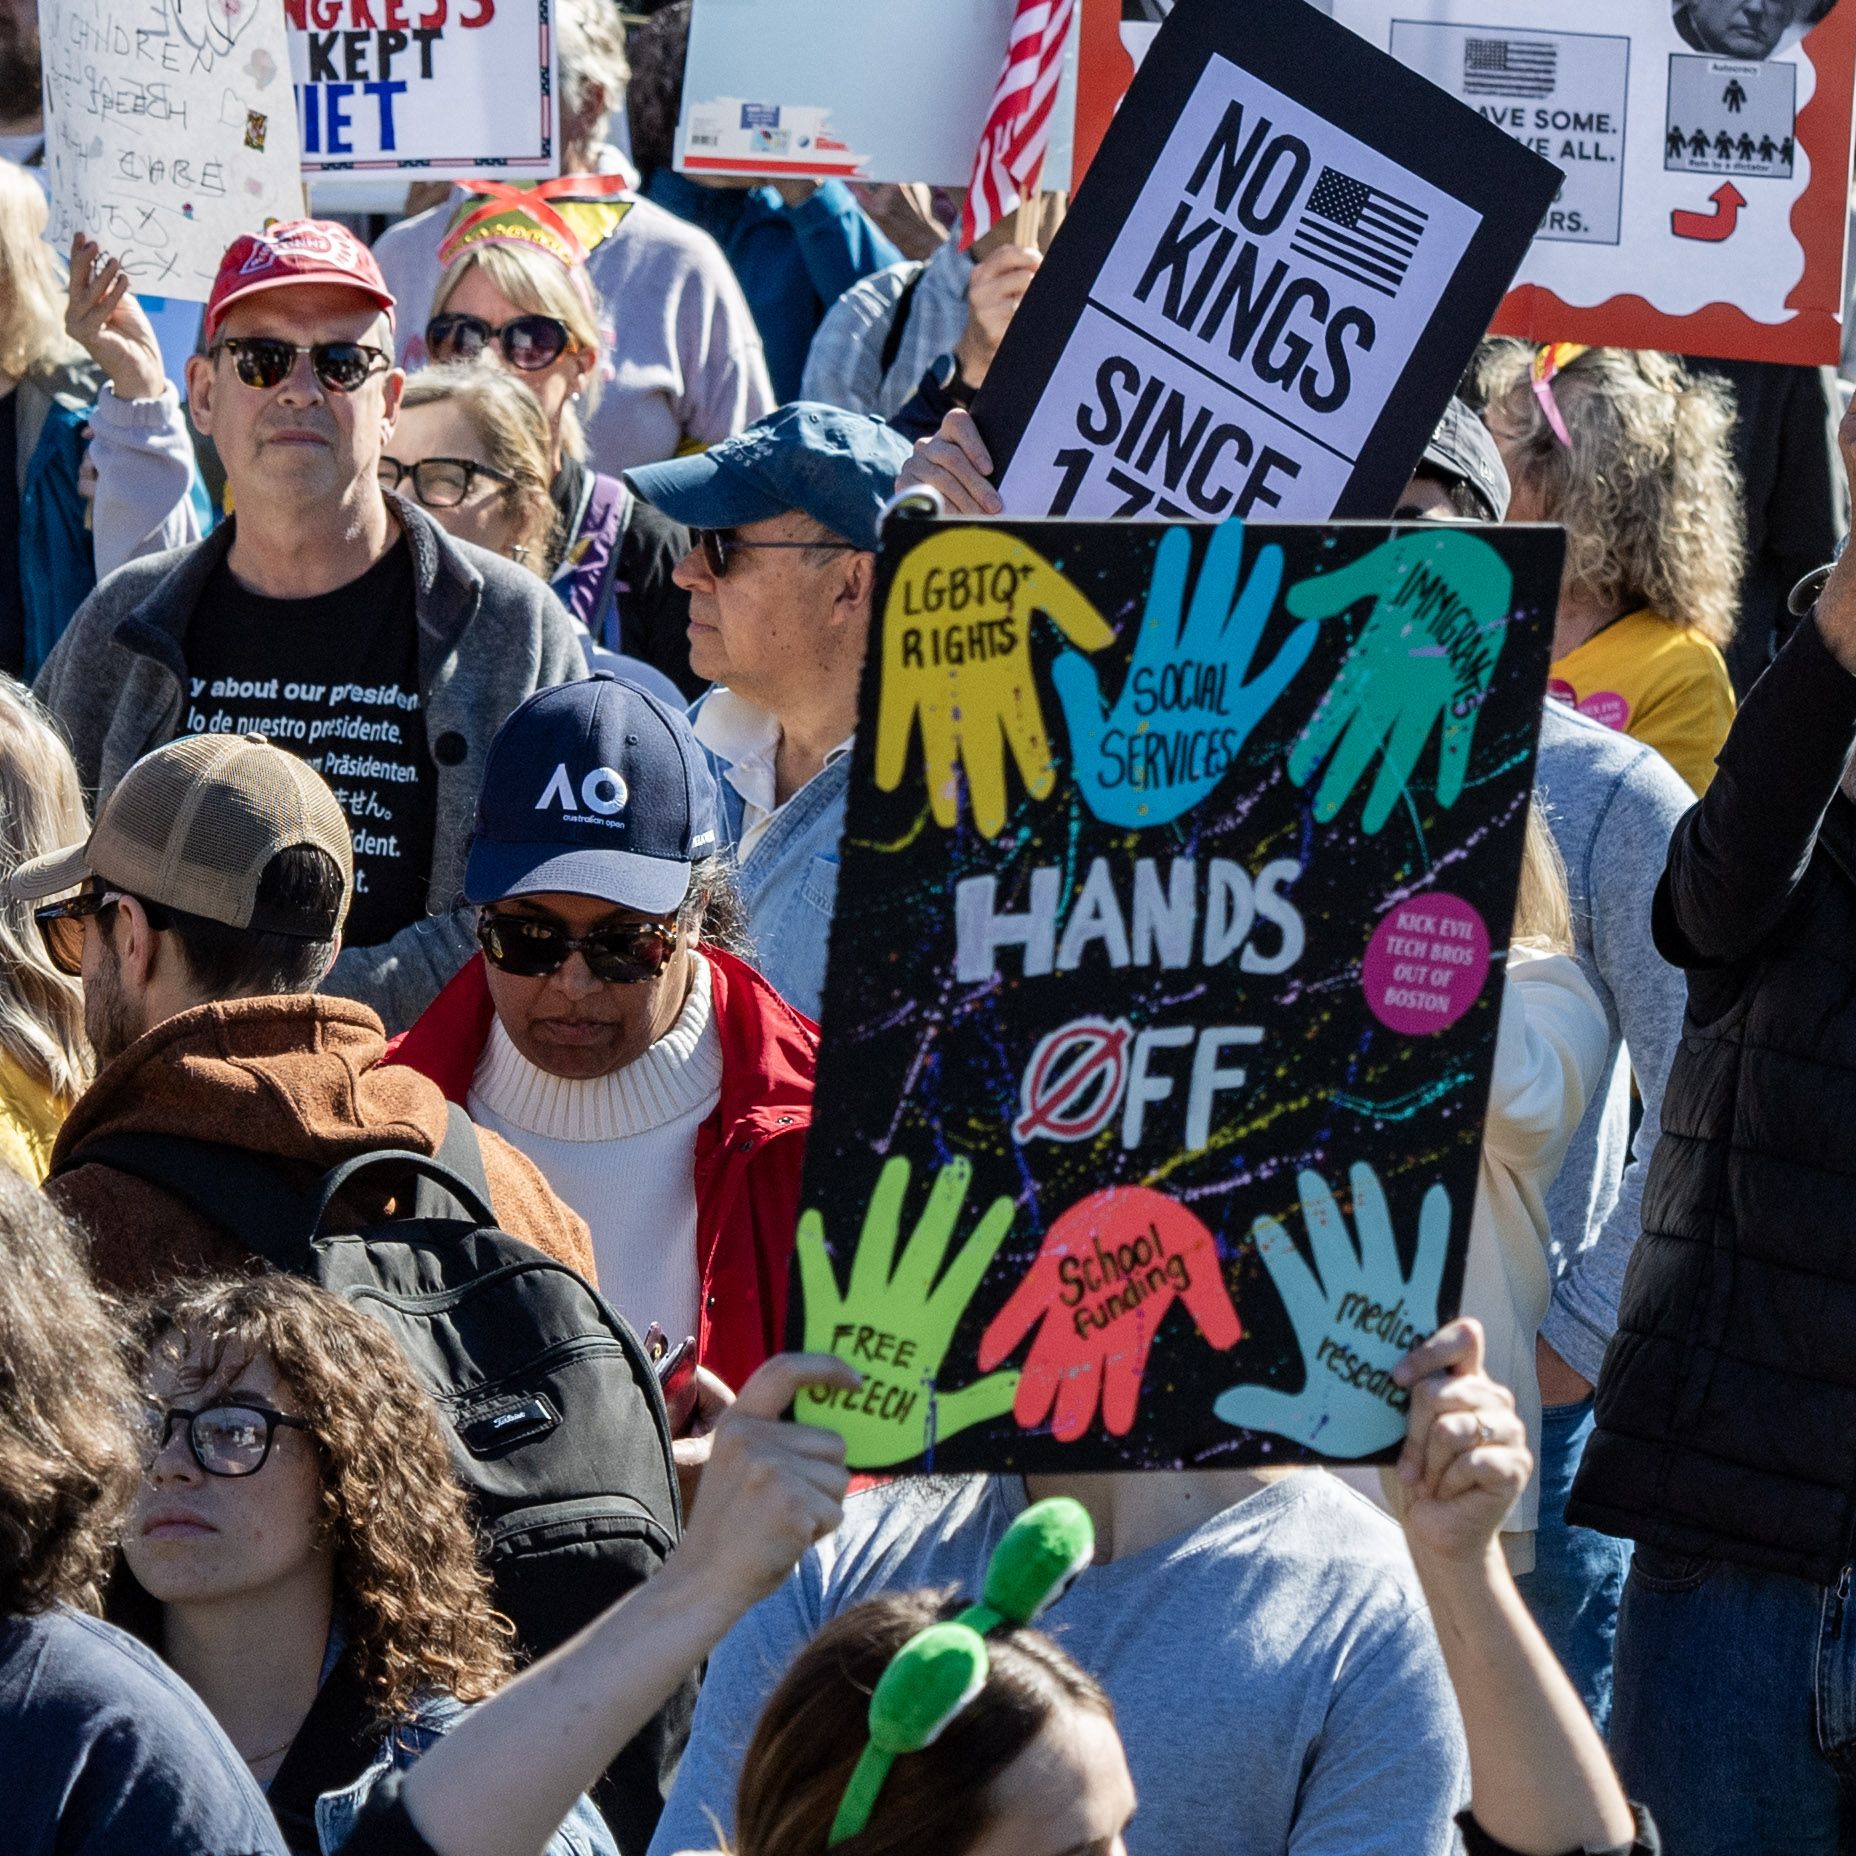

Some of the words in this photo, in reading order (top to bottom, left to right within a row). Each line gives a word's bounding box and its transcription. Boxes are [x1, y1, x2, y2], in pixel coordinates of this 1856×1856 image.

[309, 28, 444, 82] KEPT
[1711, 61, 1759, 76] Autocracy
[1535, 110, 1618, 135] SOME.
[1185, 99, 1313, 236] NO
[1560, 139, 1616, 163] ALL.
[1133, 212, 1377, 413] KINGS
[1076, 354, 1303, 519] SINCE
[902, 560, 1035, 618] LGBTQ+
[901, 616, 1021, 670] RIGHTS
[1394, 560, 1493, 719] IMMIGRANTS
[210, 677, 279, 699] about
[283, 683, 326, 700] our
[1132, 659, 1232, 718] SOCIAL
[186, 706, 206, 730] lo
[209, 710, 232, 731] de
[237, 713, 307, 738] nuestro
[309, 714, 402, 745] presidente.
[325, 752, 419, 782] Präsidenten.
[1096, 727, 1238, 792] SERVICES
[535, 763, 628, 815] AO
[562, 814, 604, 825] australian
[605, 819, 625, 829] open
[955, 857, 1308, 985] HANDS
[1396, 912, 1435, 934] KICK
[1439, 917, 1473, 940] EVIL
[1386, 935, 1428, 958] TECH
[1430, 943, 1473, 966] BROS
[1393, 963, 1428, 984] OUT
[1430, 968, 1454, 988] OF
[1384, 987, 1451, 1013] BOSTON
[1057, 1223, 1167, 1308] School
[1071, 1254, 1192, 1342] funding
[830, 1324, 918, 1369] FREE
